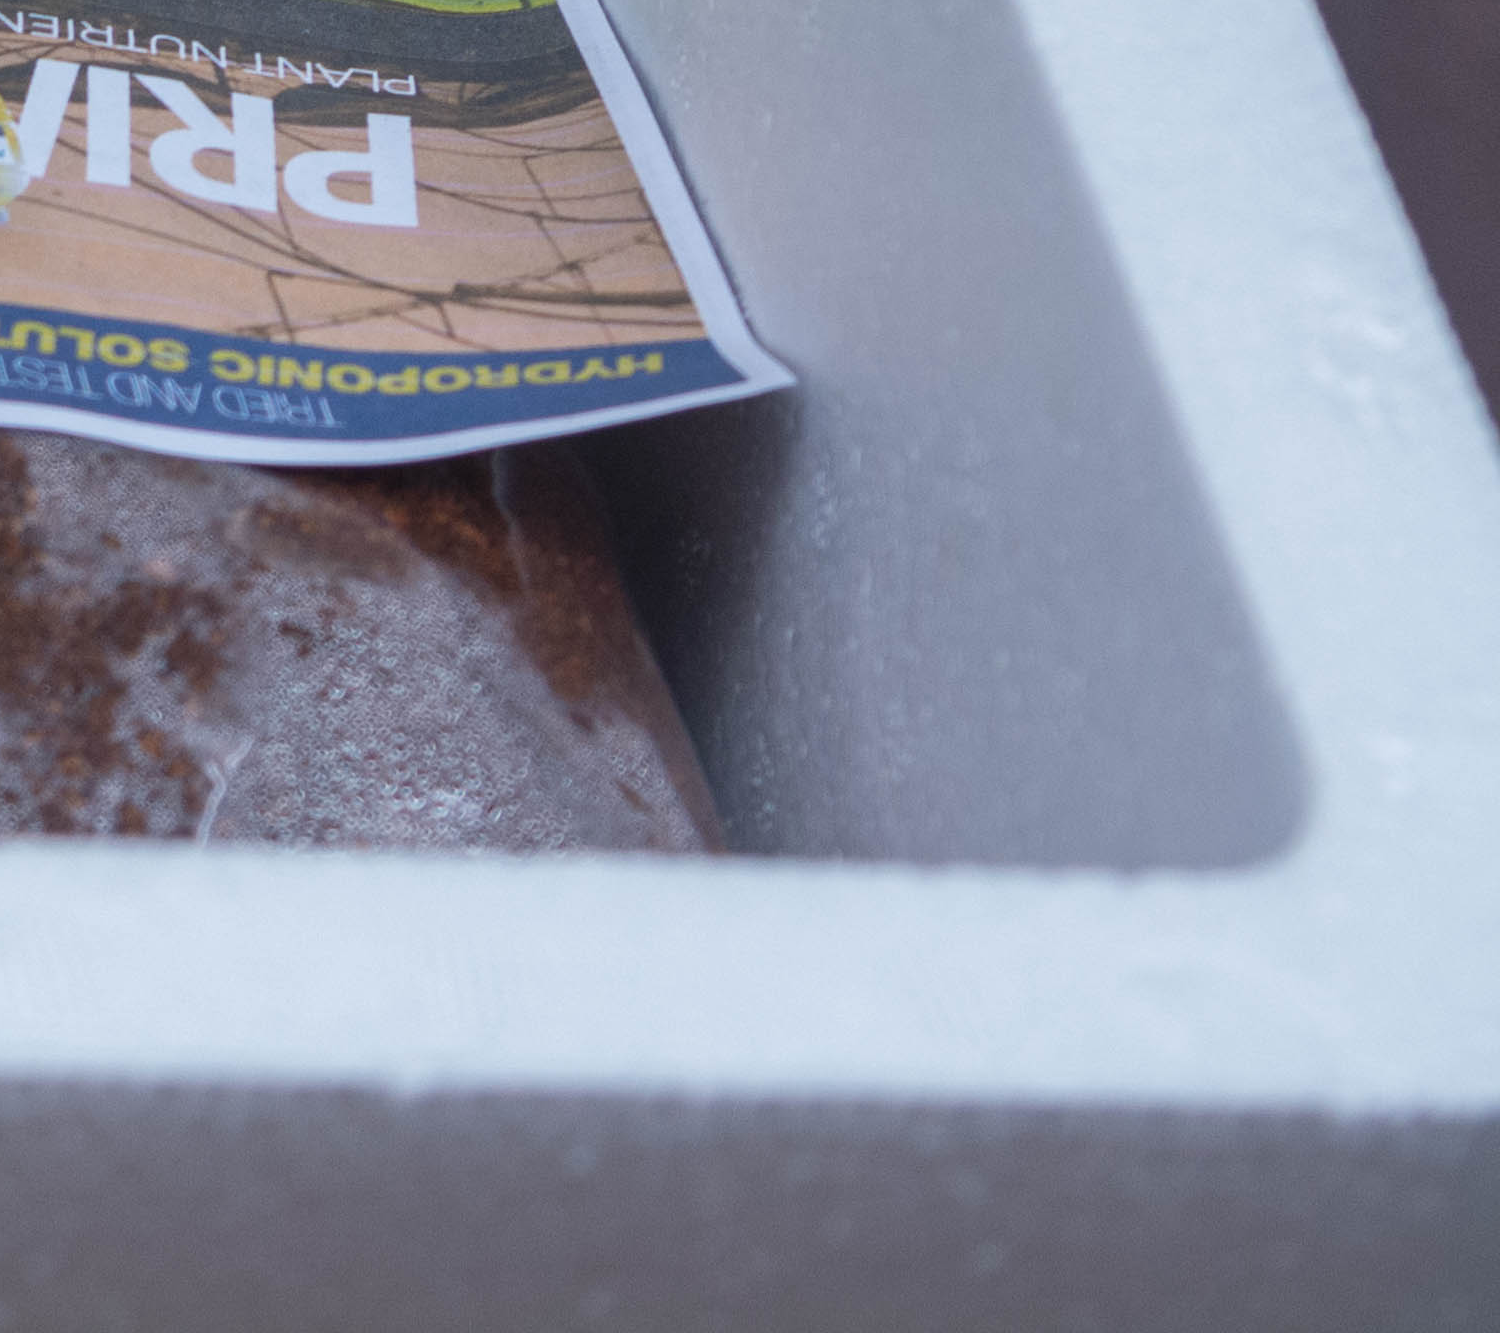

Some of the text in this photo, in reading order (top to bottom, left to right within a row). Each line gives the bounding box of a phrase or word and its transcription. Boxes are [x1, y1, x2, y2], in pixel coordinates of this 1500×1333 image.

[244, 52, 417, 97] PLANT
[106, 371, 201, 414] AND
[210, 349, 663, 395] HYDROPONIC
[212, 384, 338, 427] TRIED
